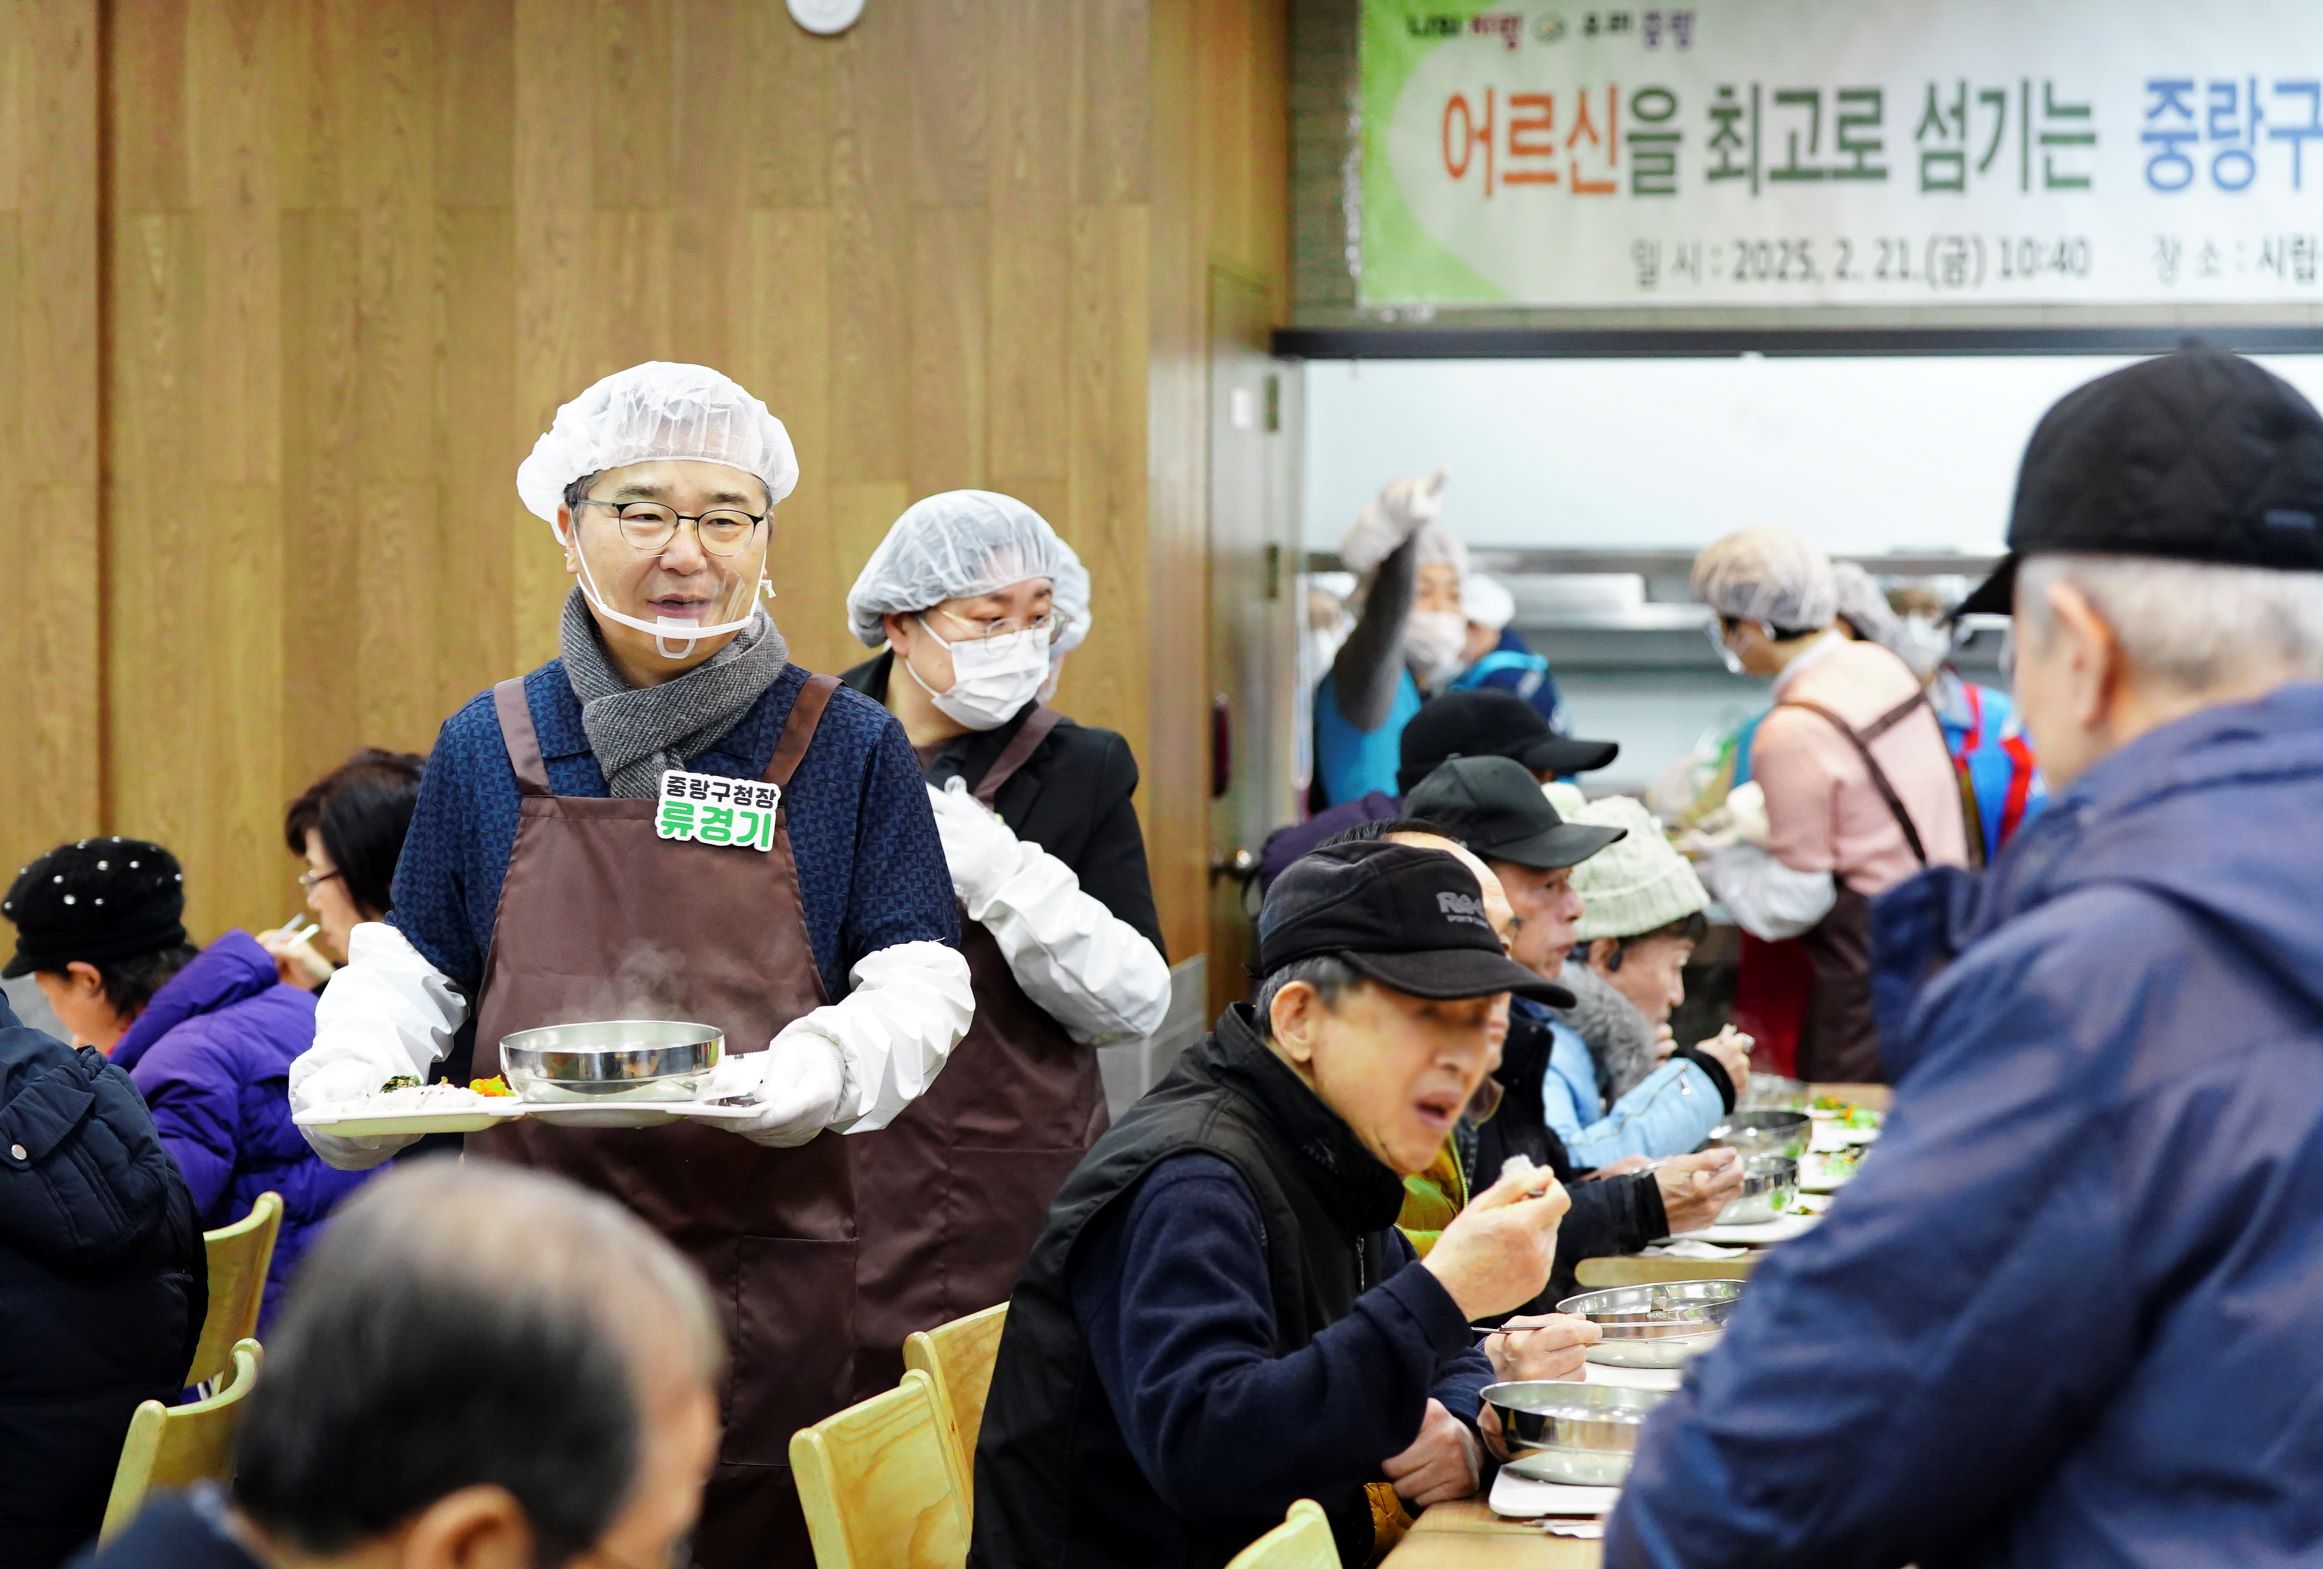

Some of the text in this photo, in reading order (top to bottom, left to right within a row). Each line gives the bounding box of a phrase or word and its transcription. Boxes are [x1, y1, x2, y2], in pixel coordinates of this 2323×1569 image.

[1441, 84, 1684, 199] 어르신을
[1704, 82, 1890, 197] 최고로
[1914, 79, 2098, 195] 섬기는
[1999, 236, 2092, 280] 10:40
[666, 775, 777, 809] 중랑구청장
[660, 800, 772, 848] 류경기
